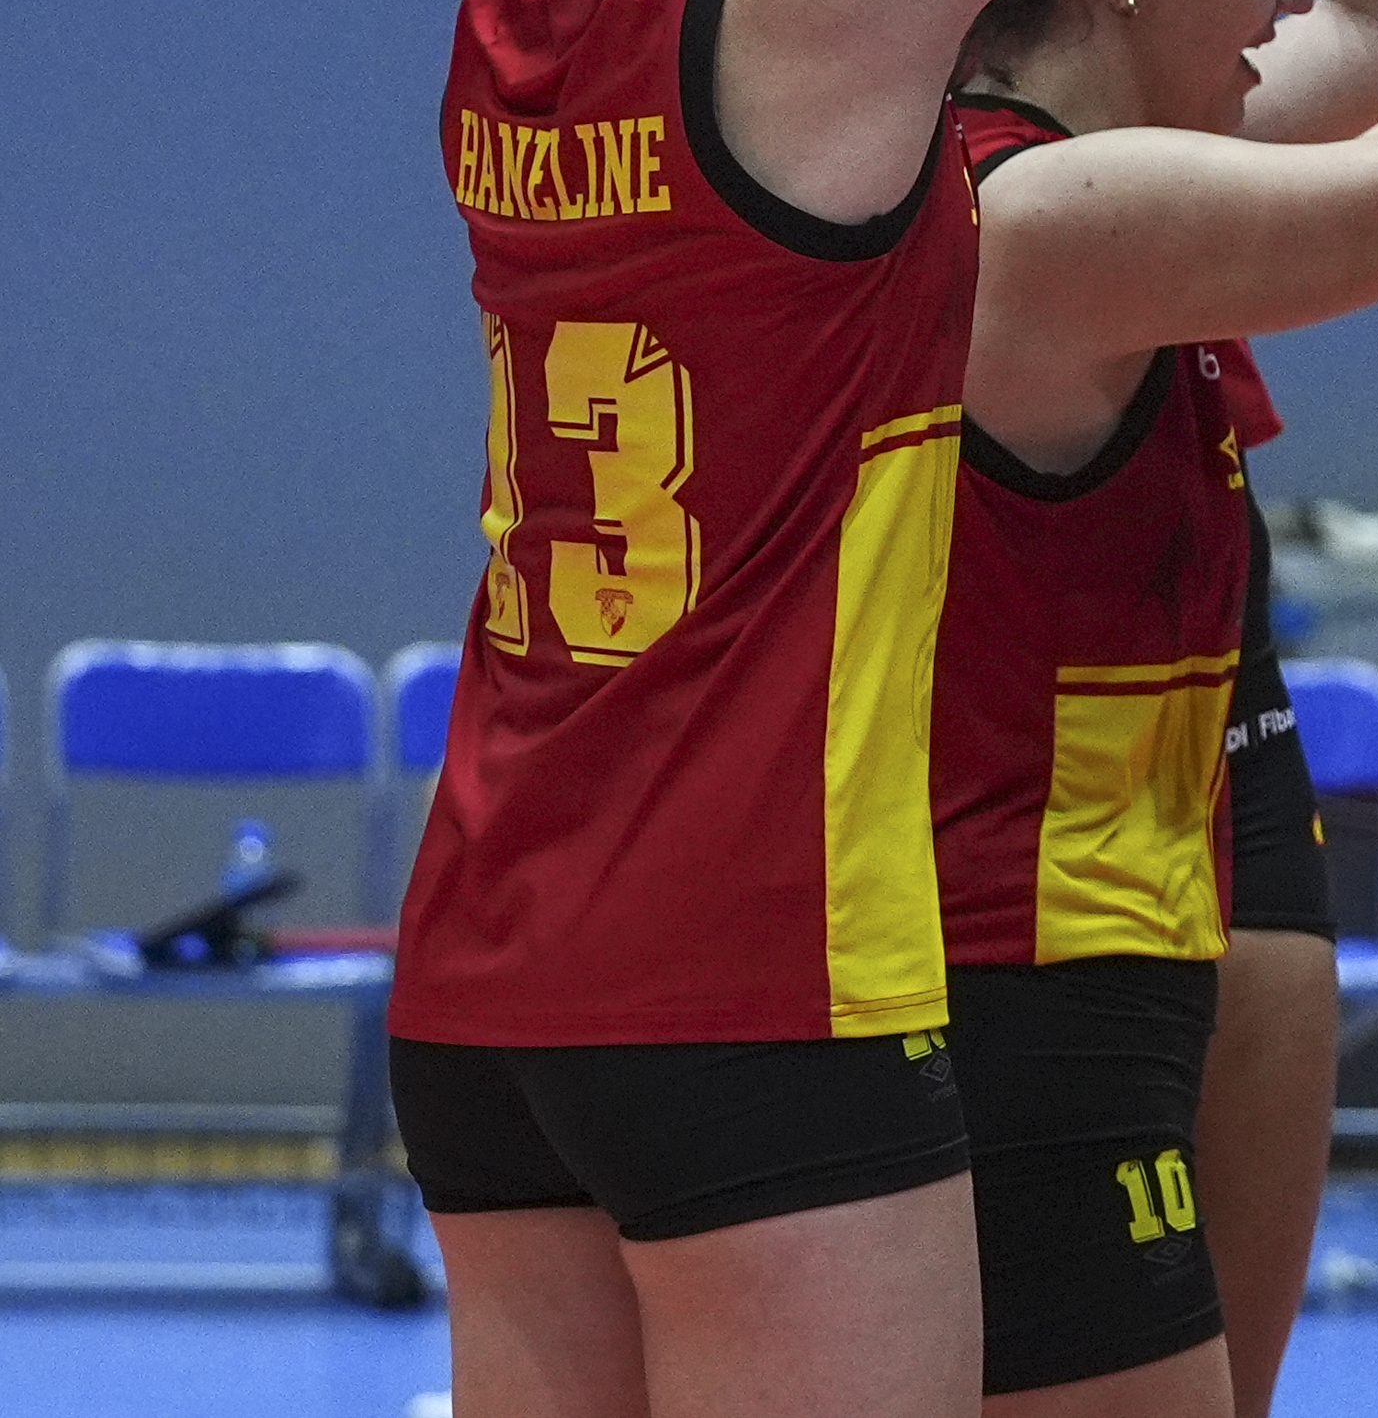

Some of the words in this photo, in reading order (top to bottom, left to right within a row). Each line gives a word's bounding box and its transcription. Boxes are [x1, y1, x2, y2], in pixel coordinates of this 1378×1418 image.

[455, 108, 672, 221] HANELINE
[480, 311, 702, 668] 13
[1116, 1148, 1197, 1243] 10
